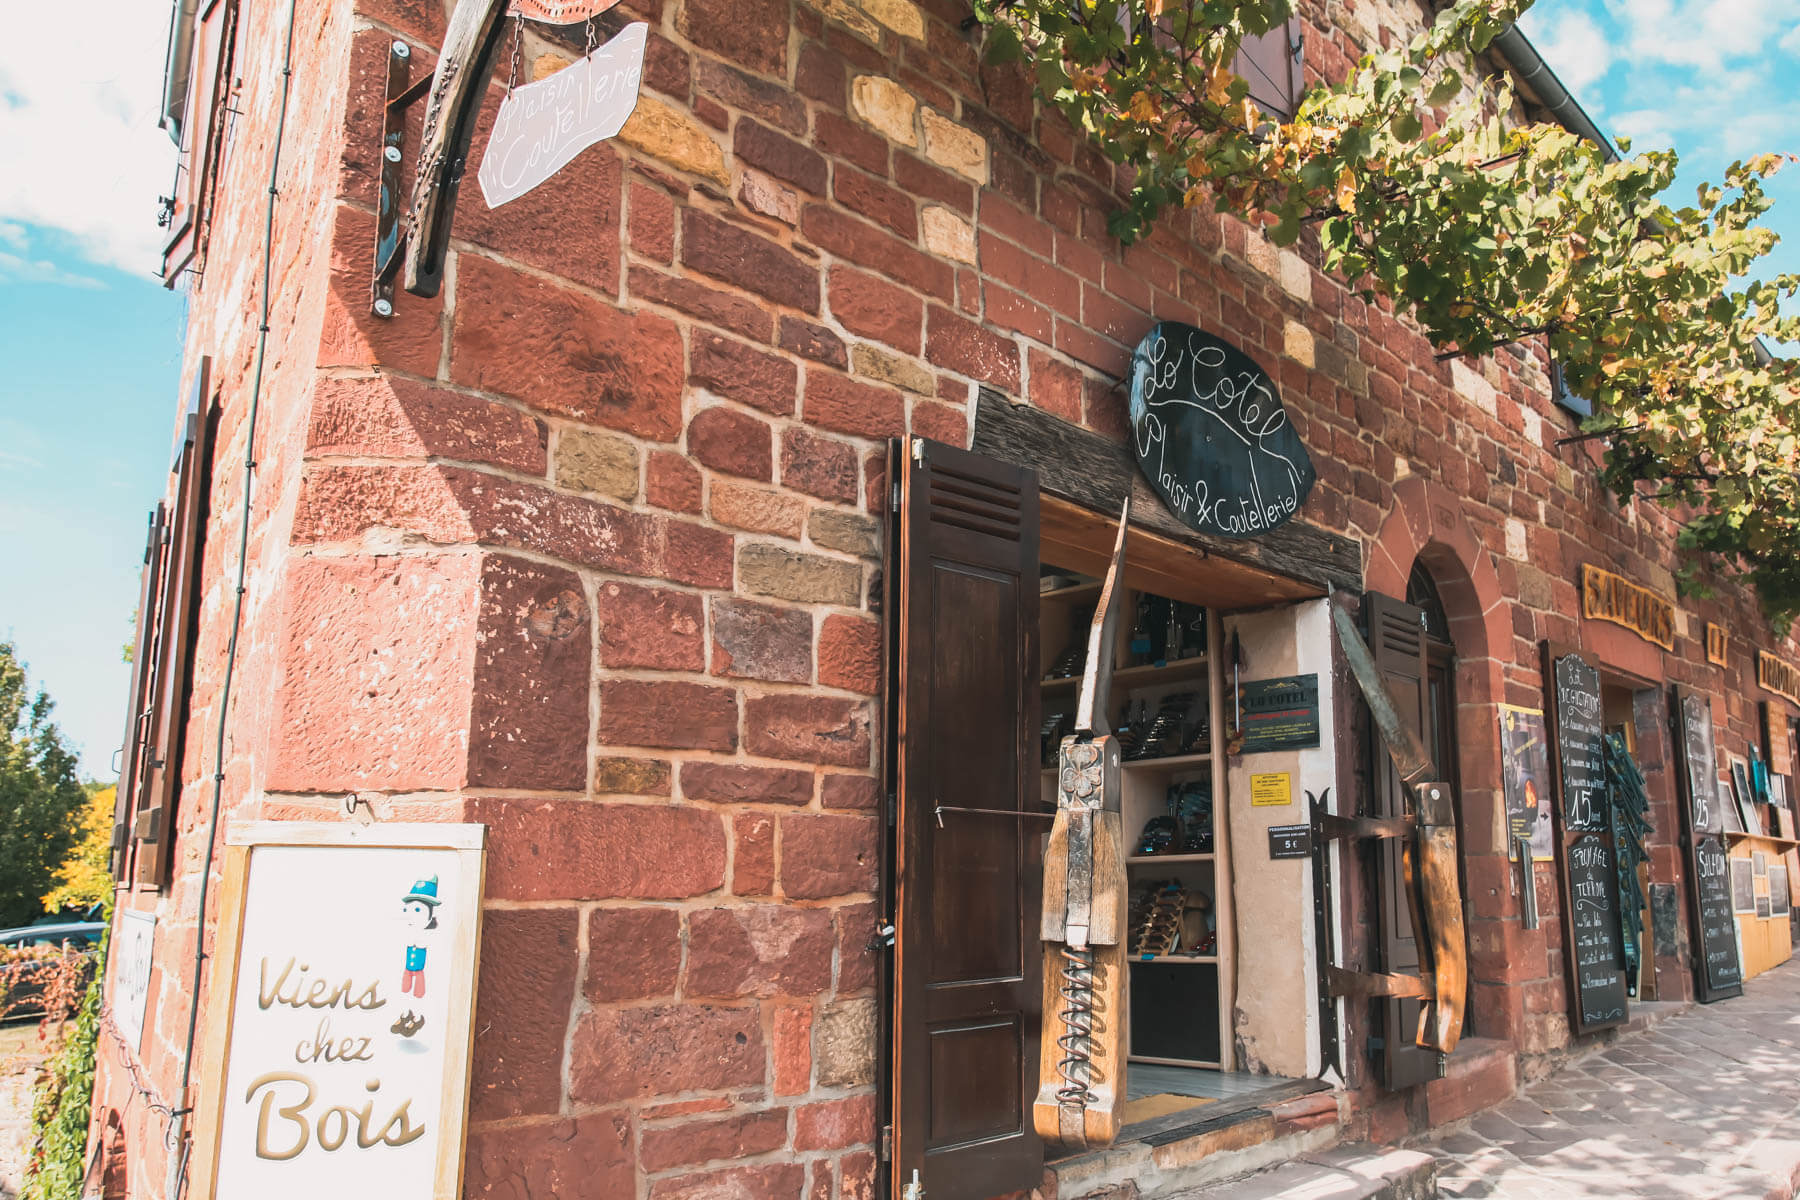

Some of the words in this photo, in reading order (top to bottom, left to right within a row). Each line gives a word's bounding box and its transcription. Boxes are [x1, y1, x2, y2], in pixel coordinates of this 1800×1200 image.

[501, 55, 640, 189] Coutellerie
[1144, 336, 1184, 399] Lo
[1135, 404, 1194, 513] Plaisir
[1213, 449, 1298, 535] Coutellerie
[1587, 567, 1673, 645] SAVEURS
[1571, 789, 1592, 827] 15
[1695, 798, 1709, 828] 25
[1284, 840, 1291, 849] 5
[258, 955, 387, 1011] Viens
[295, 1015, 374, 1064] chez
[245, 1070, 426, 1162] Bois
